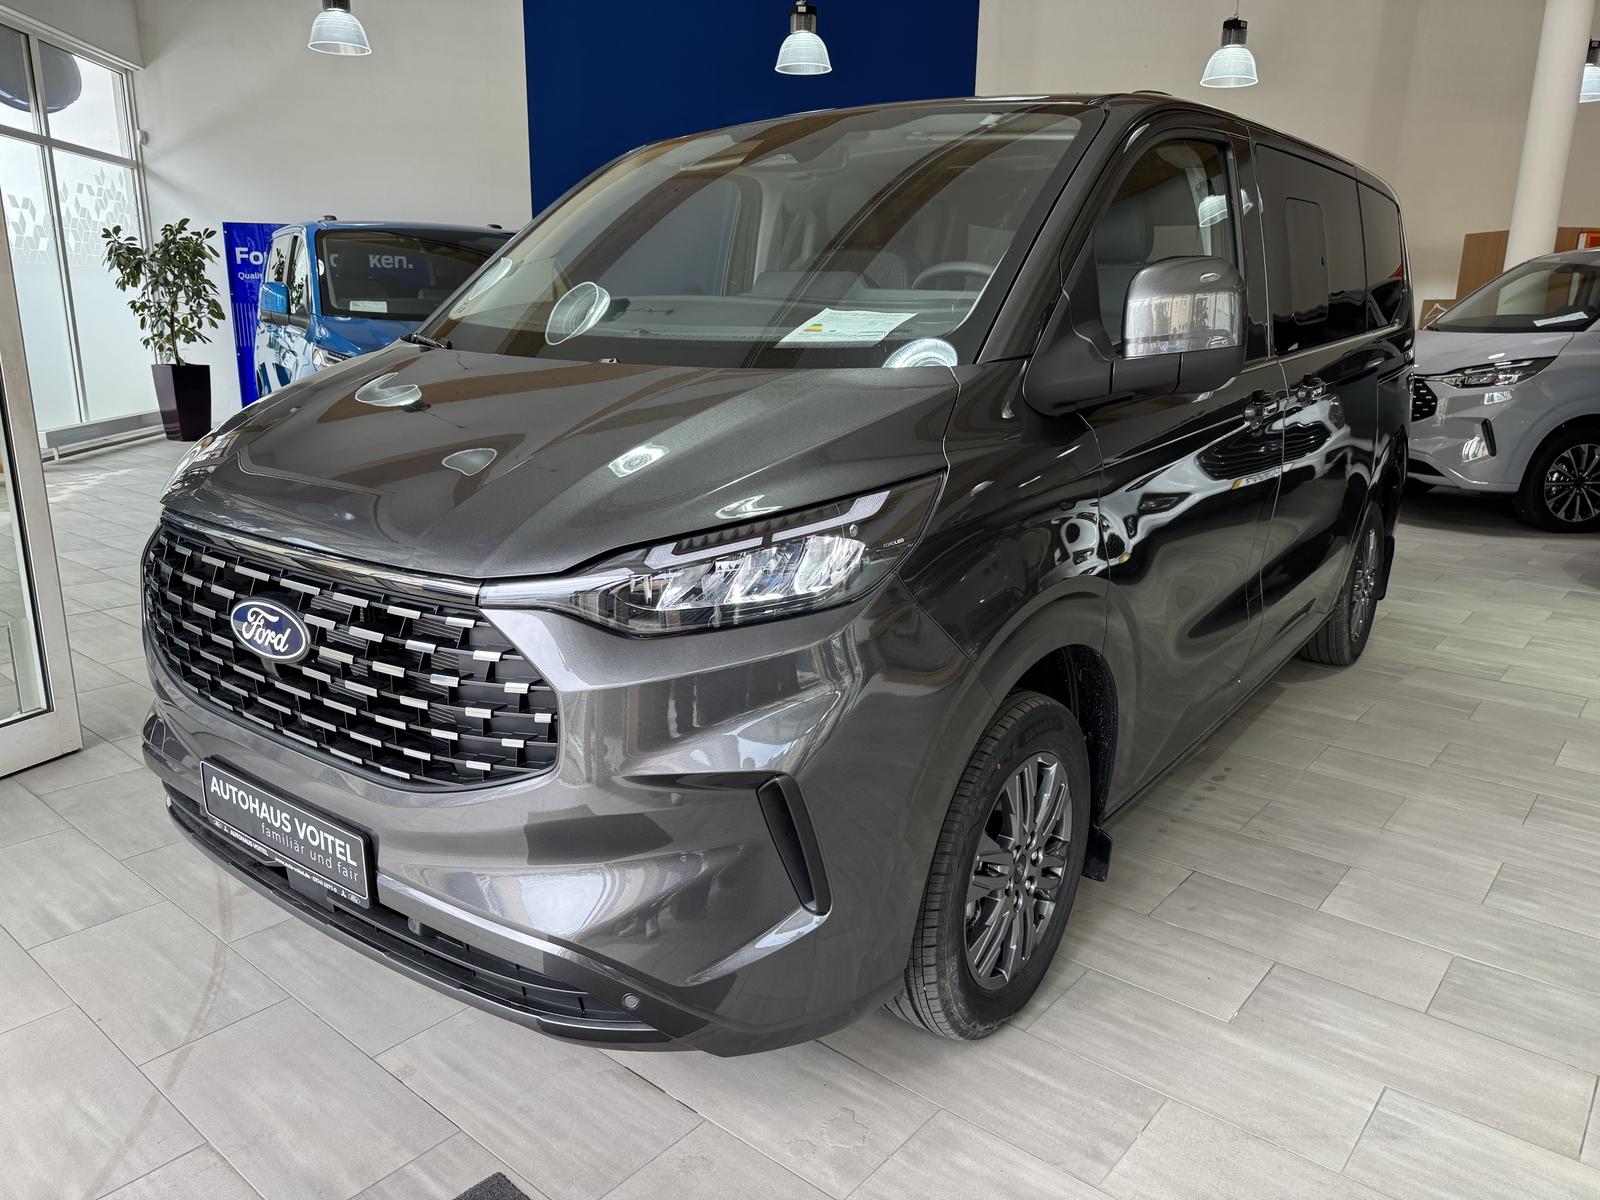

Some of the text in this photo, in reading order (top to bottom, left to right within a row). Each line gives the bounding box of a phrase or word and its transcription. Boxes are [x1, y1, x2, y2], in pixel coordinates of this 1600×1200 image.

[242, 607, 291, 652] Ford
[210, 776, 358, 867] AUTOHAUS VOITEL
[261, 822, 359, 883] familiär und fair
